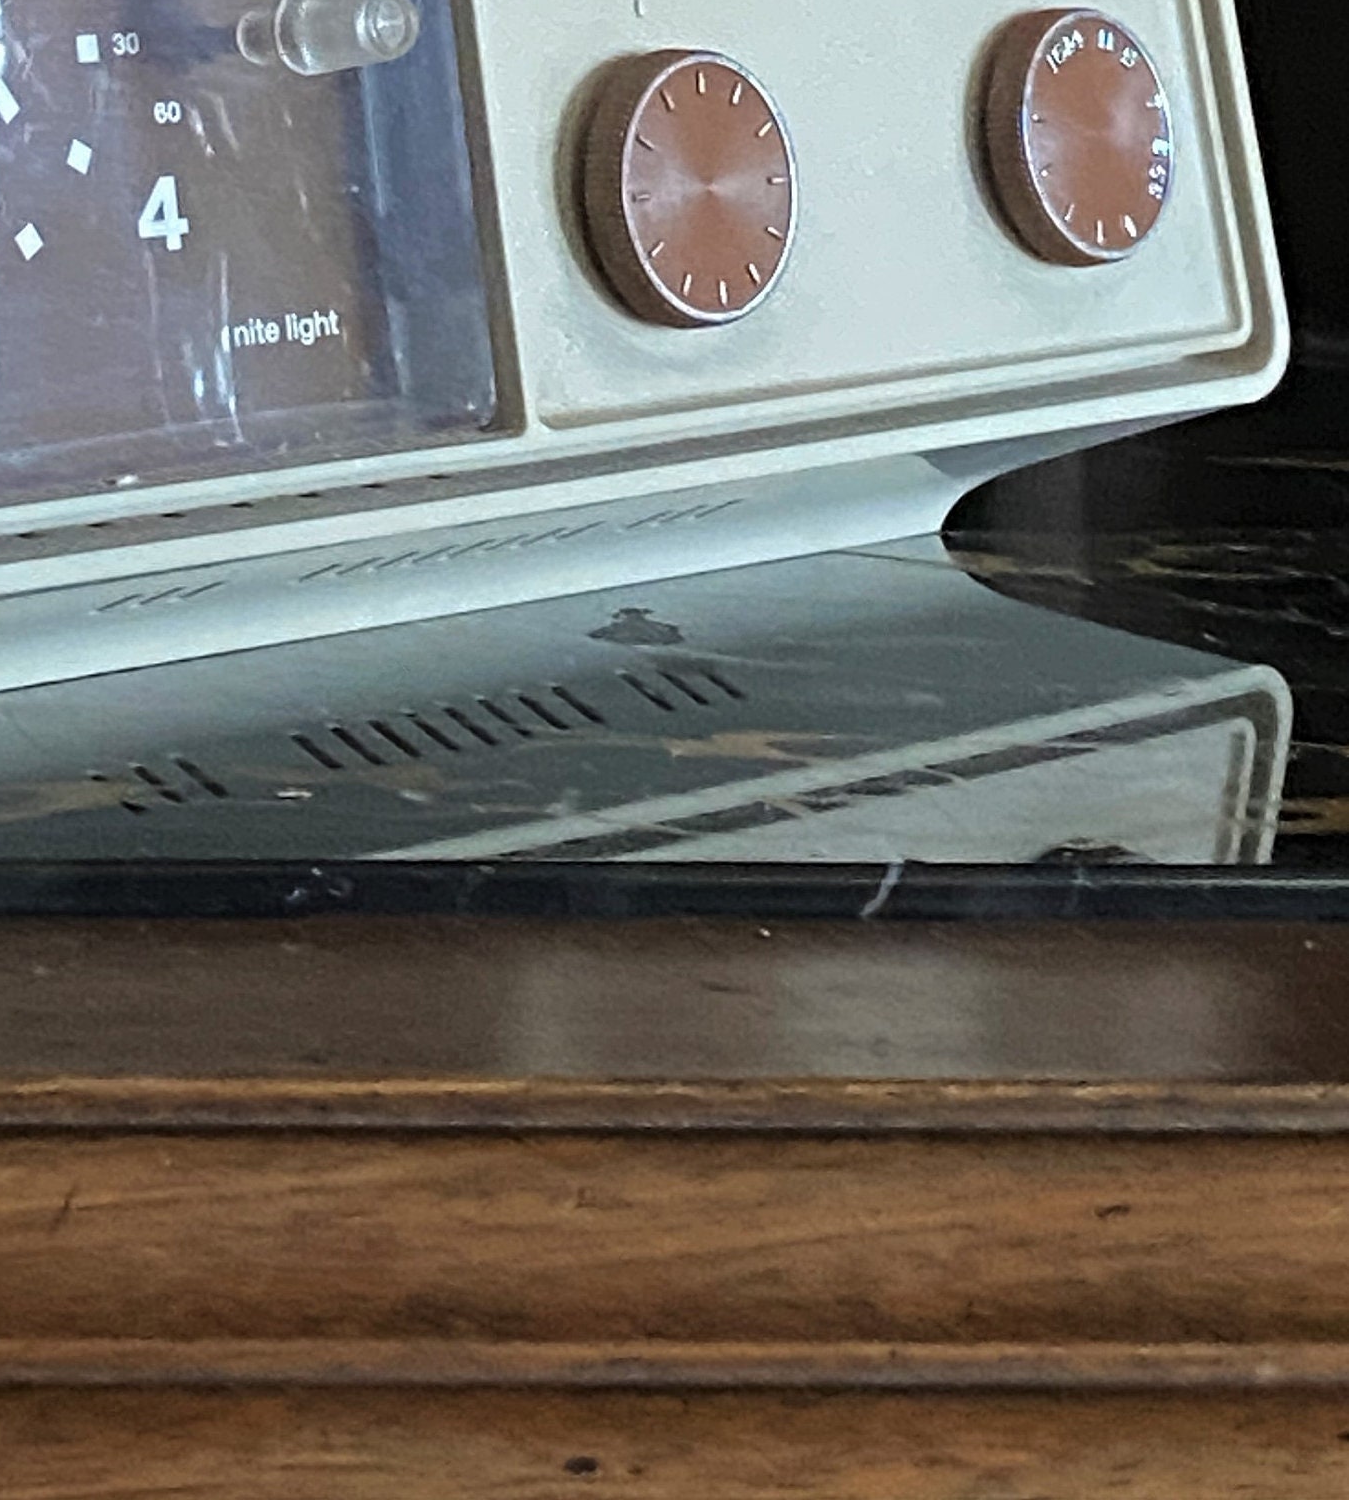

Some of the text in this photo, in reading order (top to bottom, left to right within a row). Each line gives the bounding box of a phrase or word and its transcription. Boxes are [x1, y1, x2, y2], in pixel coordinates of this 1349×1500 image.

[112, 33, 139, 55] 30
[153, 101, 182, 124] 60
[137, 175, 190, 252] 4
[233, 309, 341, 348] nite light
